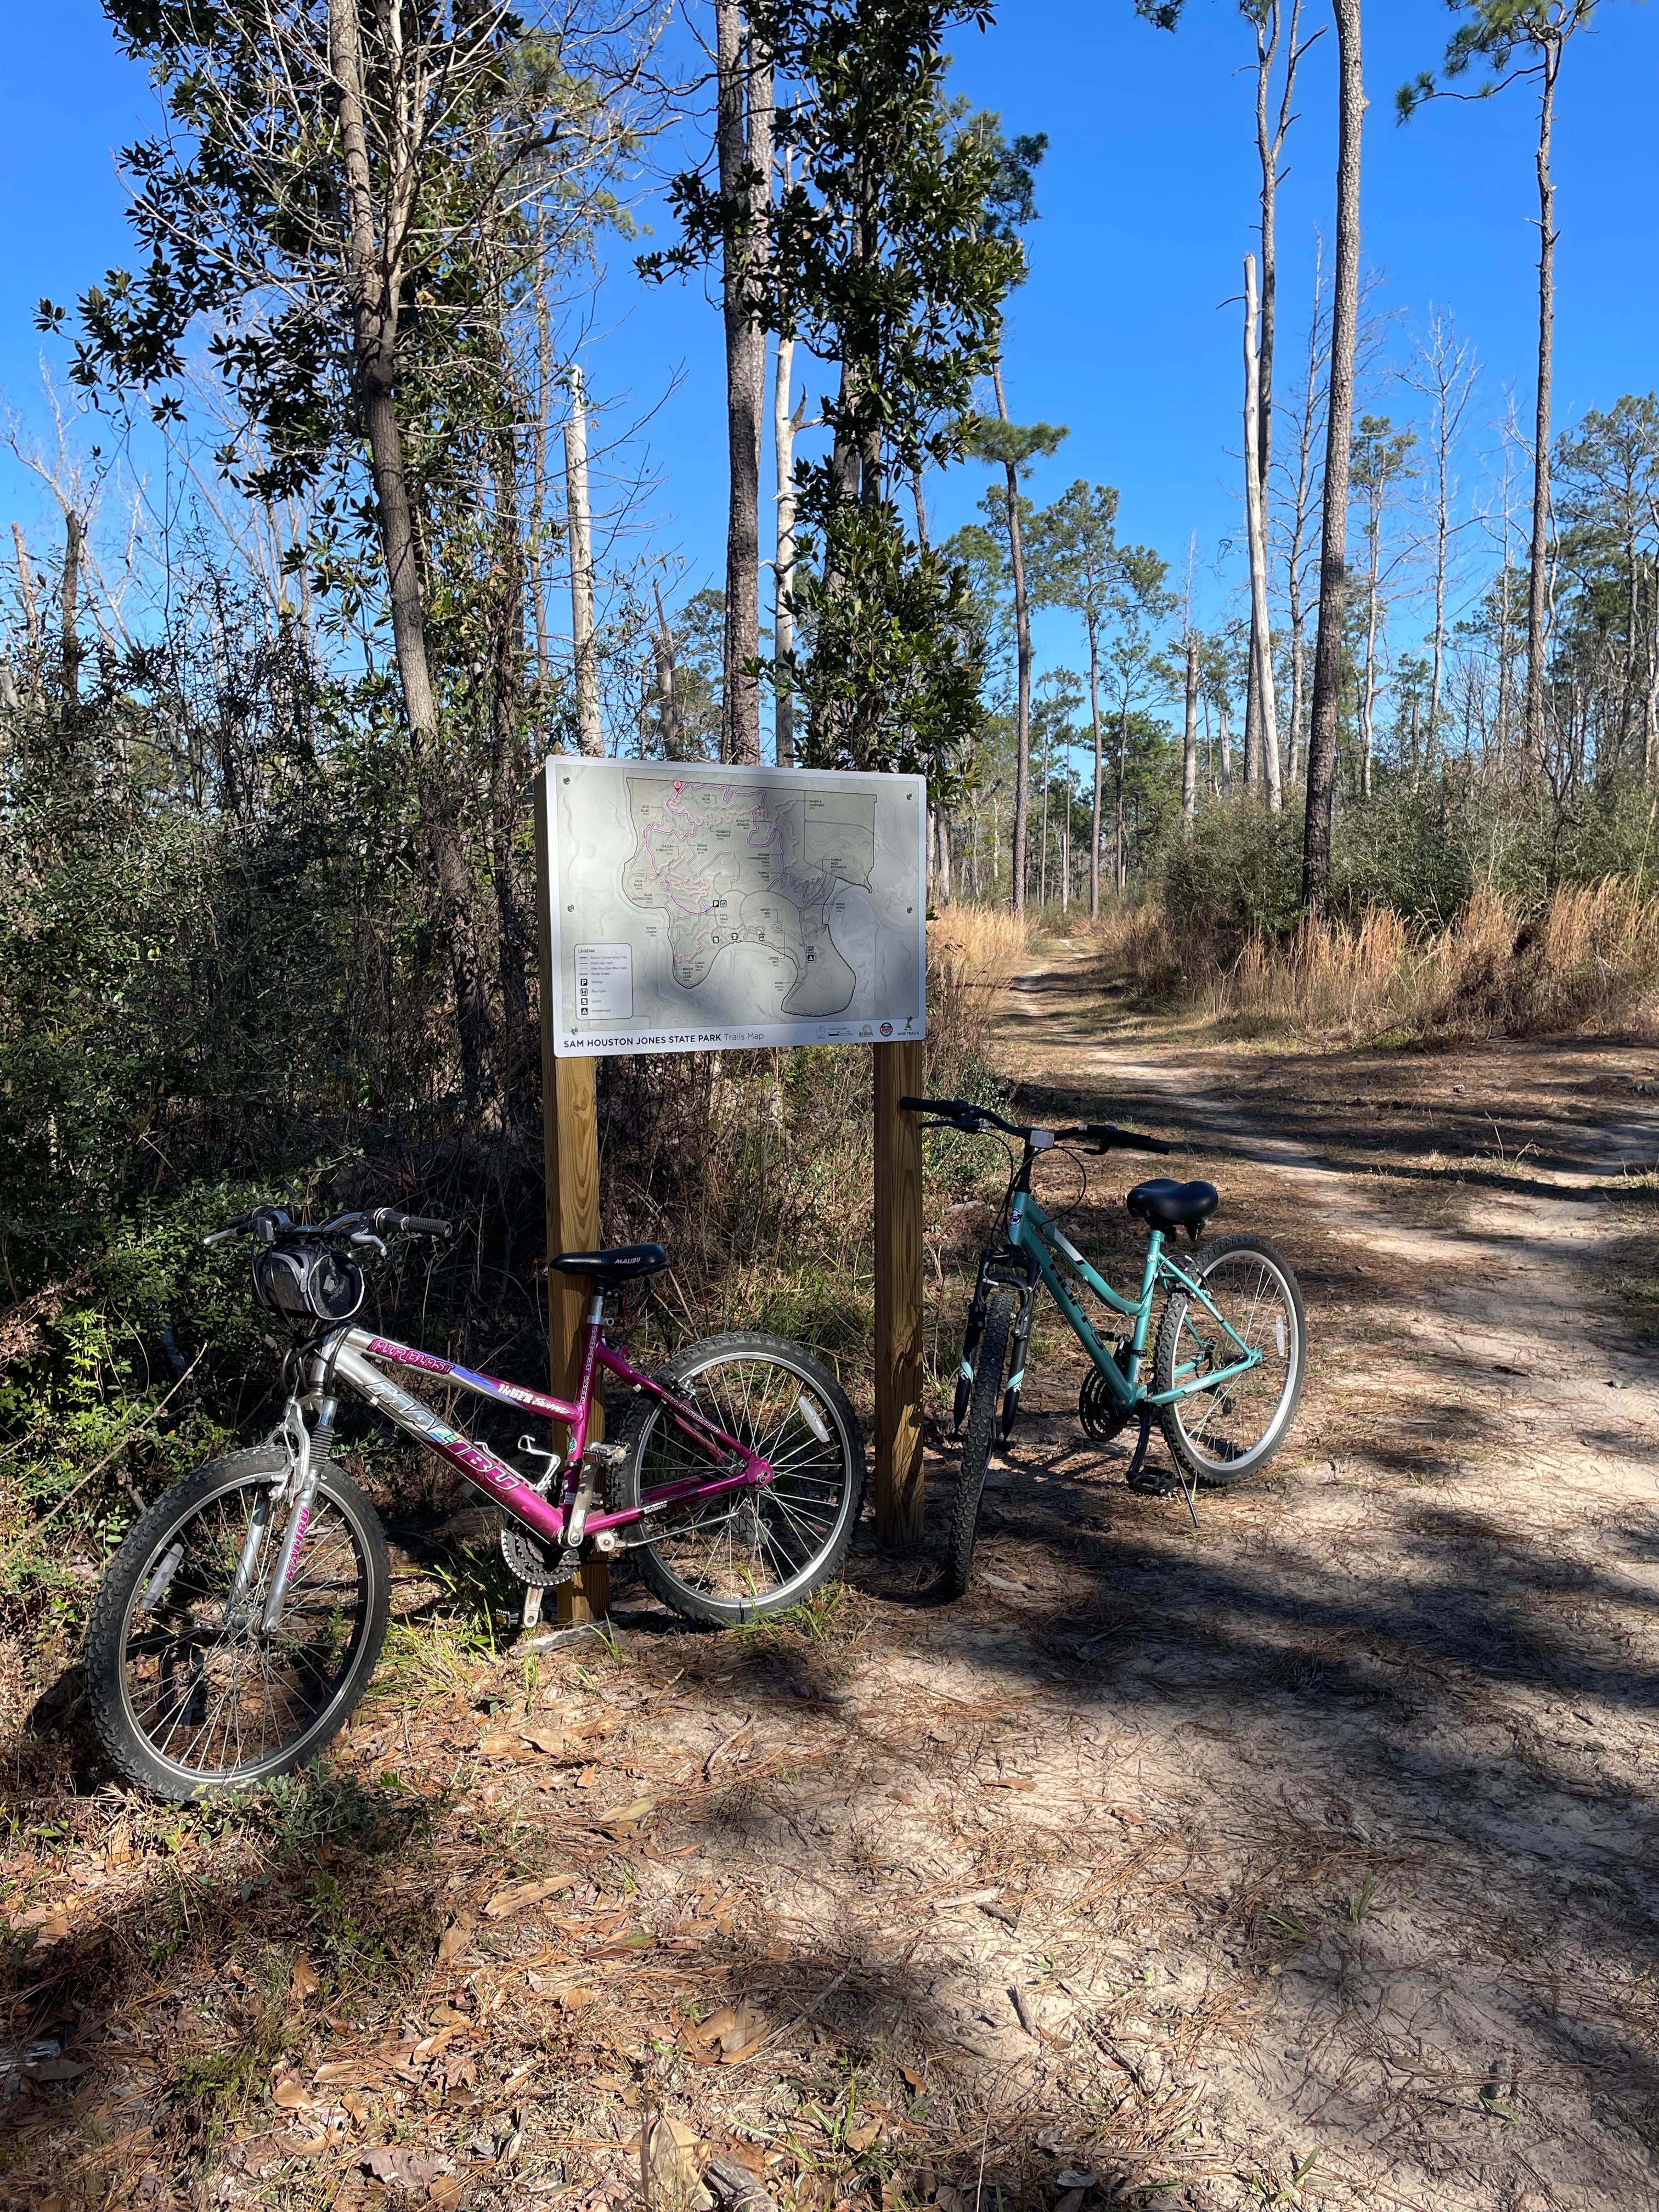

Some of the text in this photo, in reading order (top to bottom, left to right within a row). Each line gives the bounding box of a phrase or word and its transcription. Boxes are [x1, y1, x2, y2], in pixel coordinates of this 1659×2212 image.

[563, 1032, 764, 1048] SAM HOUSTON JONES STATE PARK Trails Map
[580, 1326, 597, 1404] ALUMINUM FRAME
[365, 1381, 521, 1491] MALIBU
[678, 1403, 703, 1423] CANTILEVER
[703, 1420, 721, 1434] BRAKES
[285, 1506, 309, 1584] MALIBU
